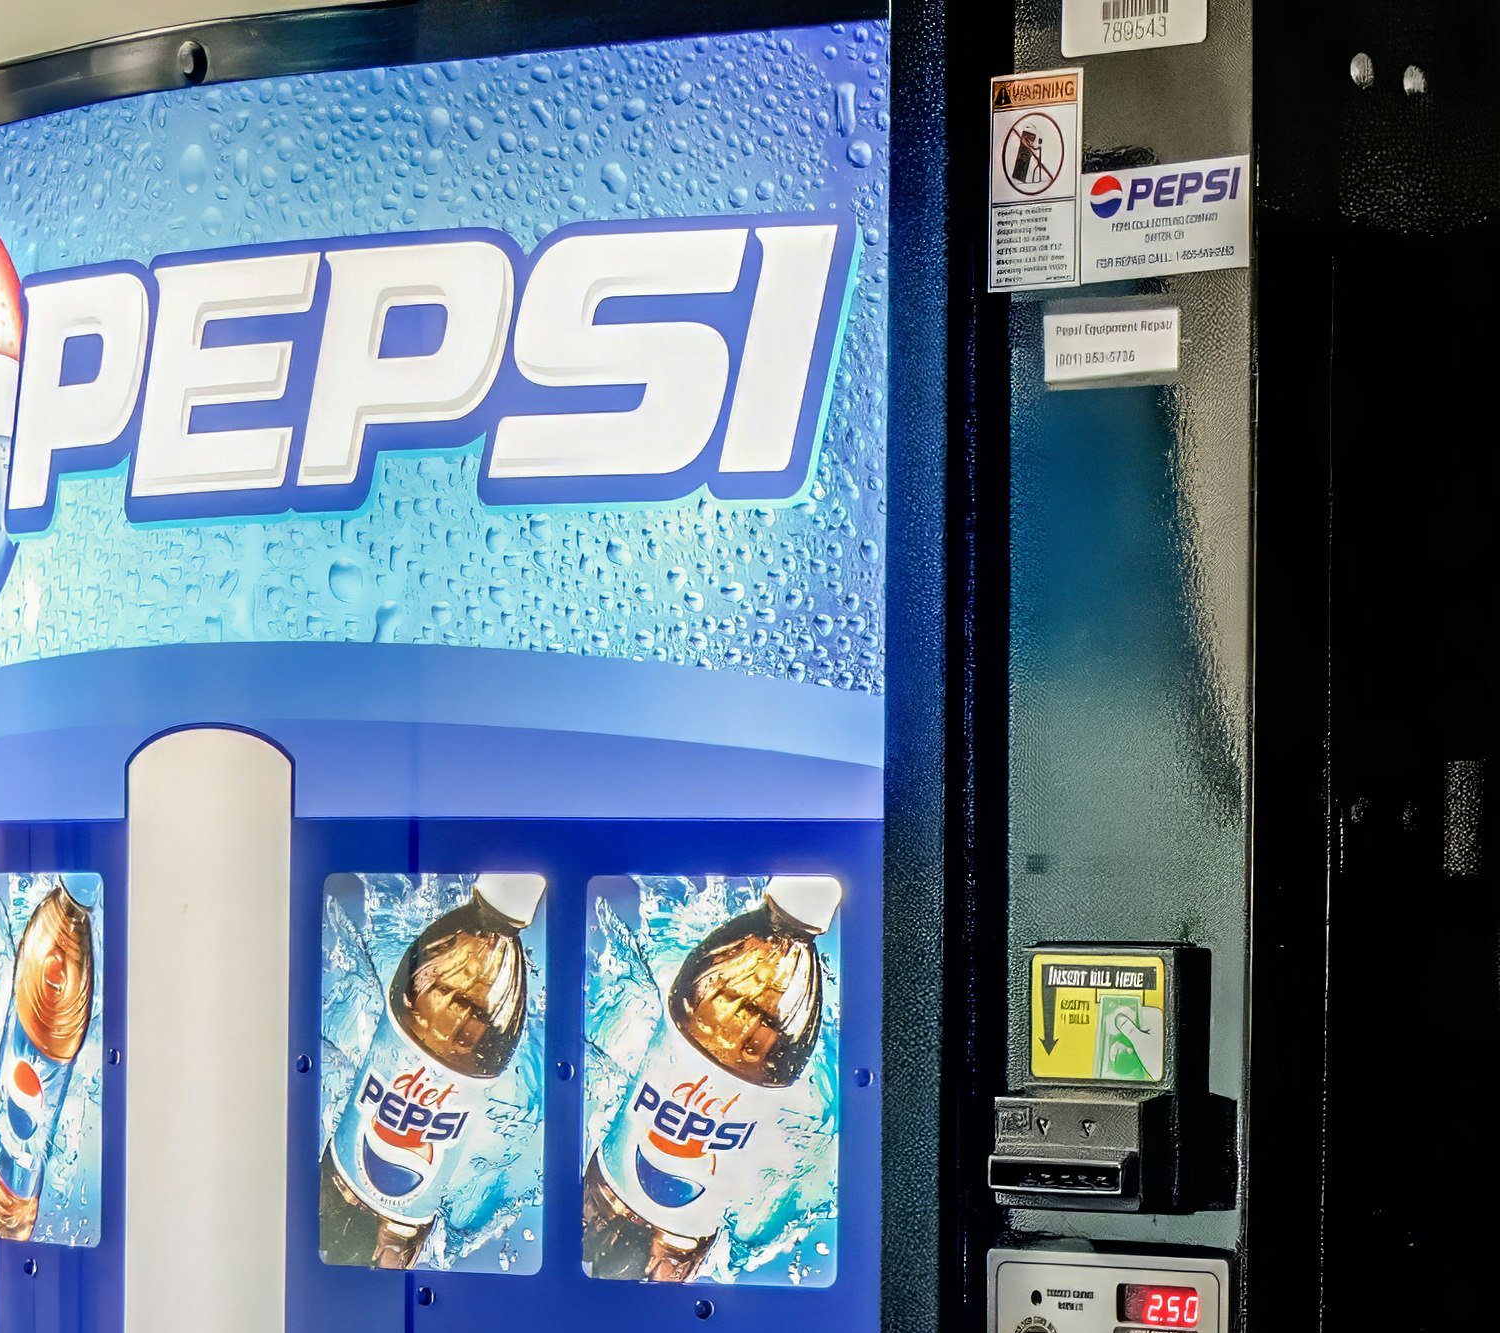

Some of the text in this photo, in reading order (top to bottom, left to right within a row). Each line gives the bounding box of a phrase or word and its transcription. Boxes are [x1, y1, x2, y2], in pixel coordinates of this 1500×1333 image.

[1127, 167, 1241, 212] PEPSI
[8, 222, 842, 512] PEPSI
[1048, 966, 1088, 986] INSERT
[360, 1073, 470, 1141] PEPSI
[633, 1081, 758, 1151] PEPSI
[1146, 1294, 1199, 1323] 2.50
